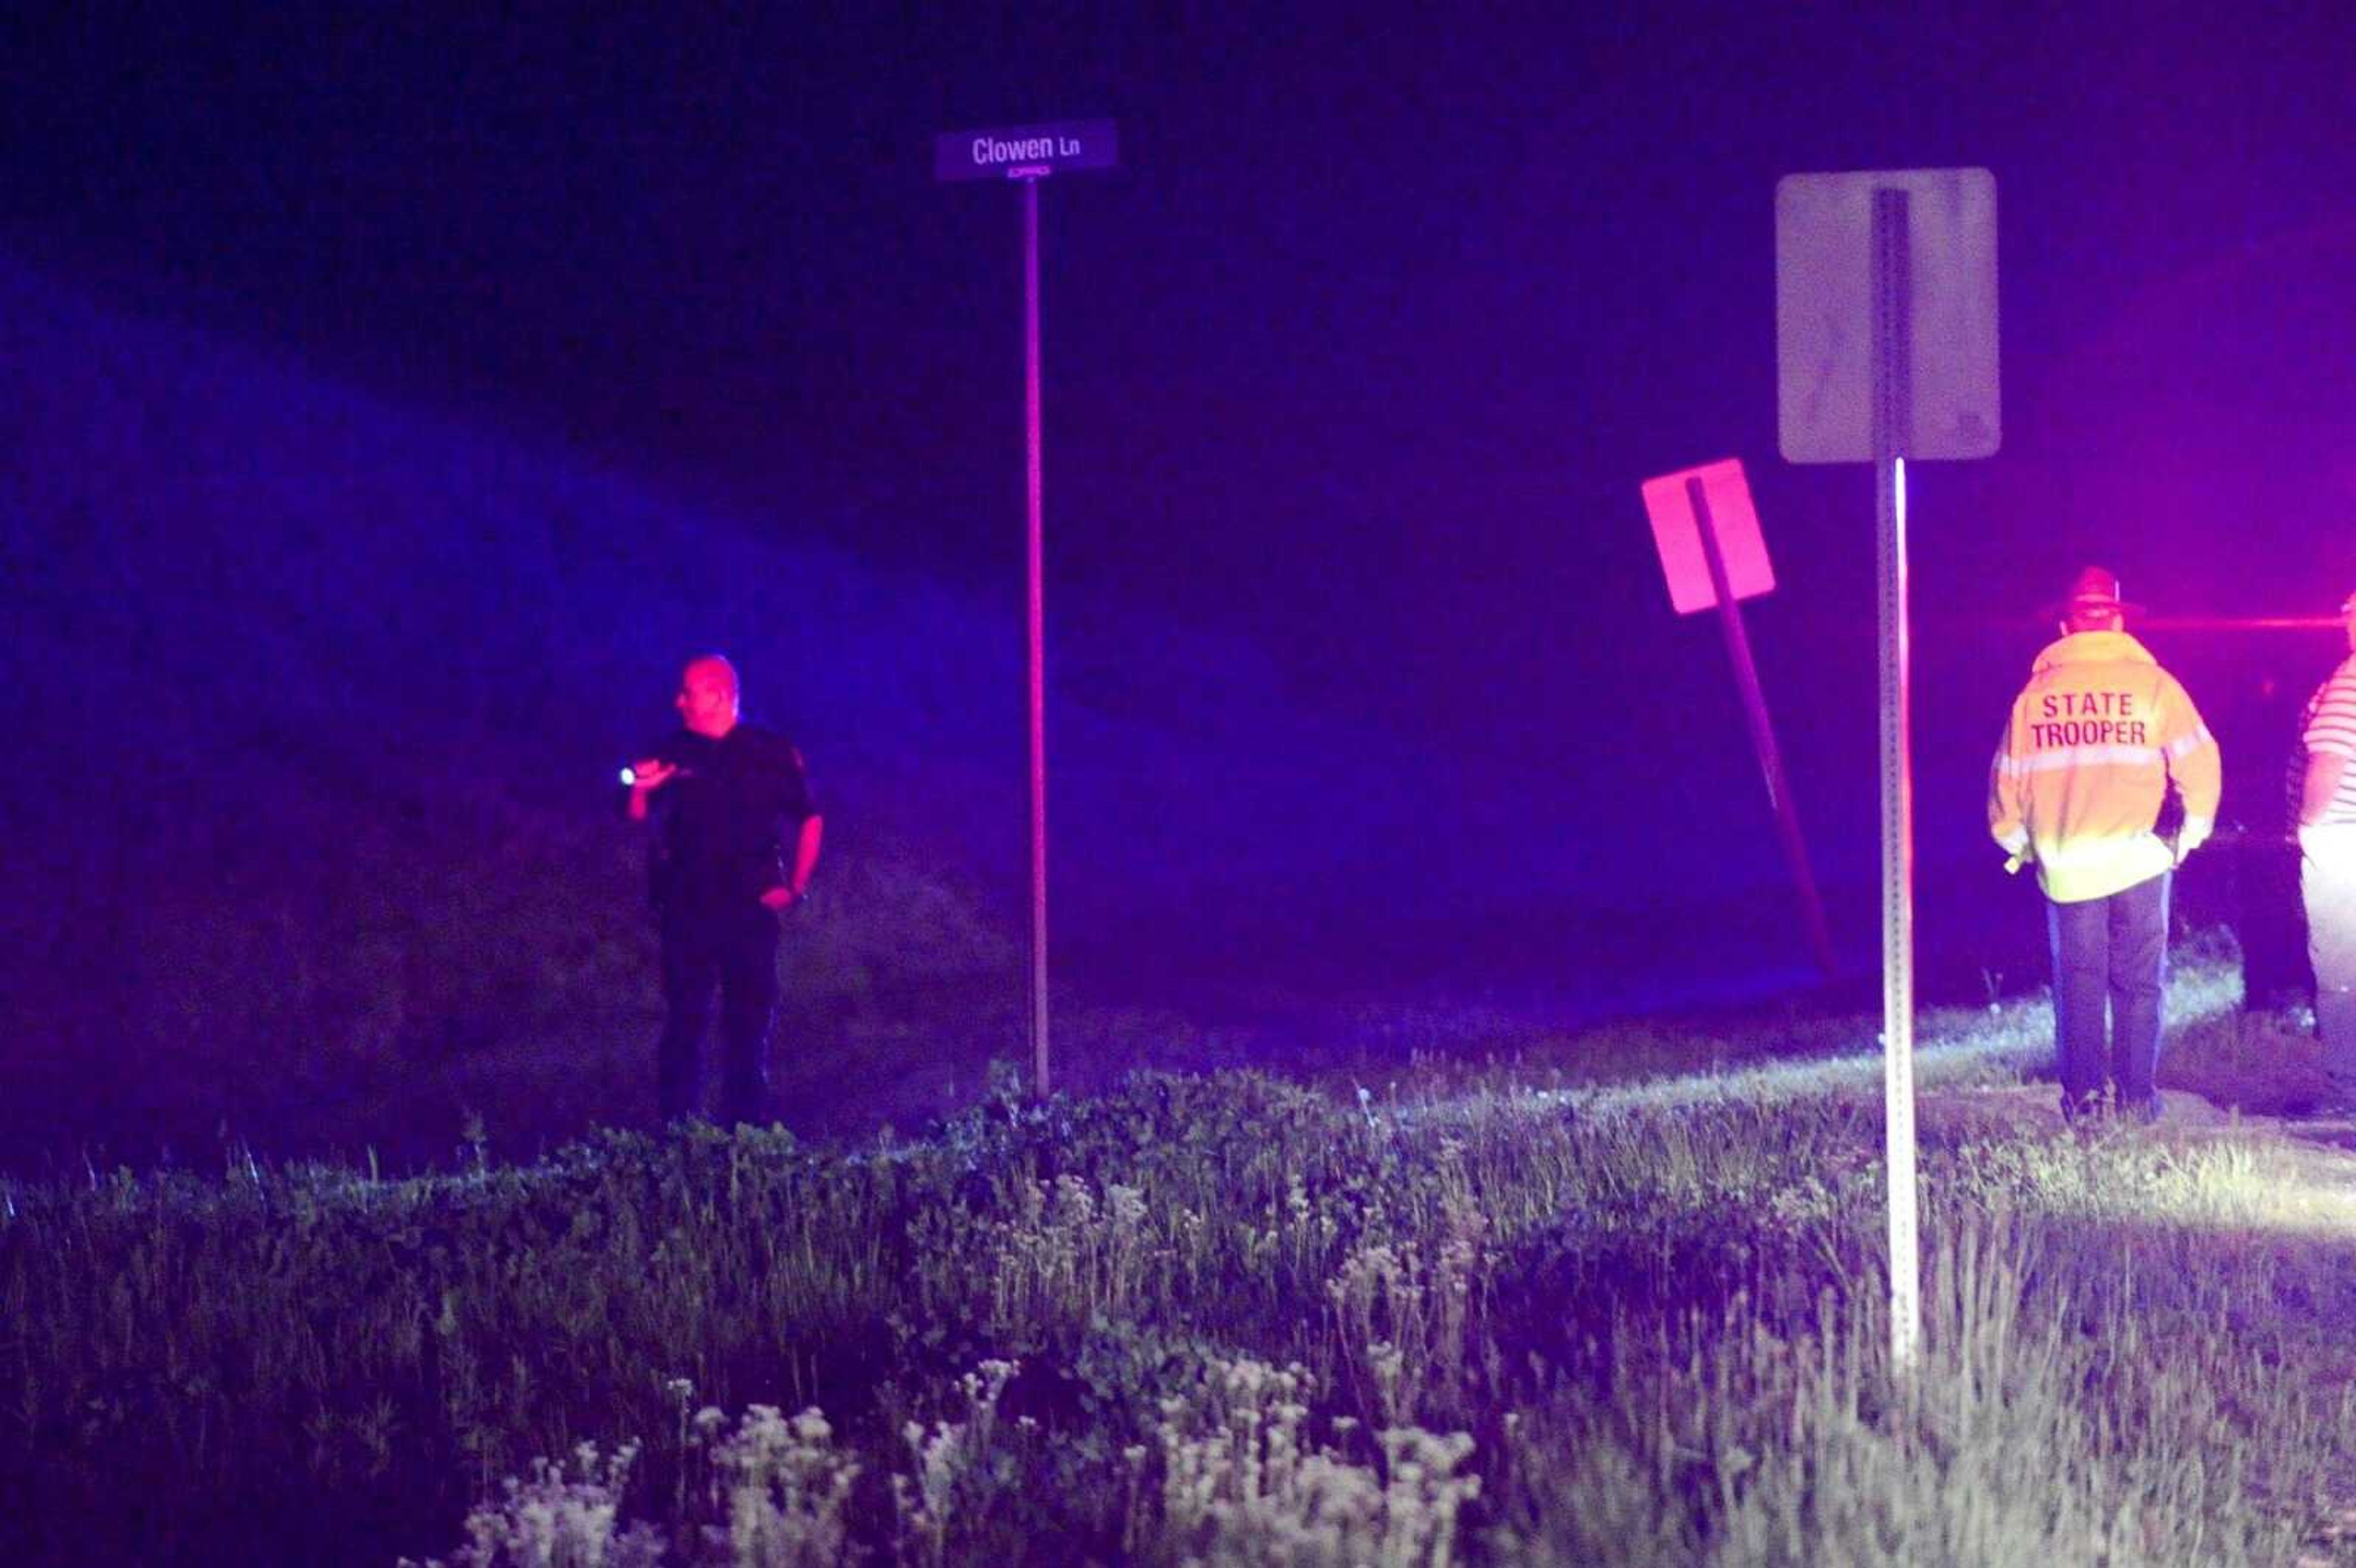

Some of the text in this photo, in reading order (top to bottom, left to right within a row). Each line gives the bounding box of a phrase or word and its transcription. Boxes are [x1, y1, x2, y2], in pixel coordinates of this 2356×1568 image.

[972, 137, 1080, 165] Clowen Ln
[2043, 693, 2133, 718] STATE
[2031, 720, 2146, 748] TROOPER
